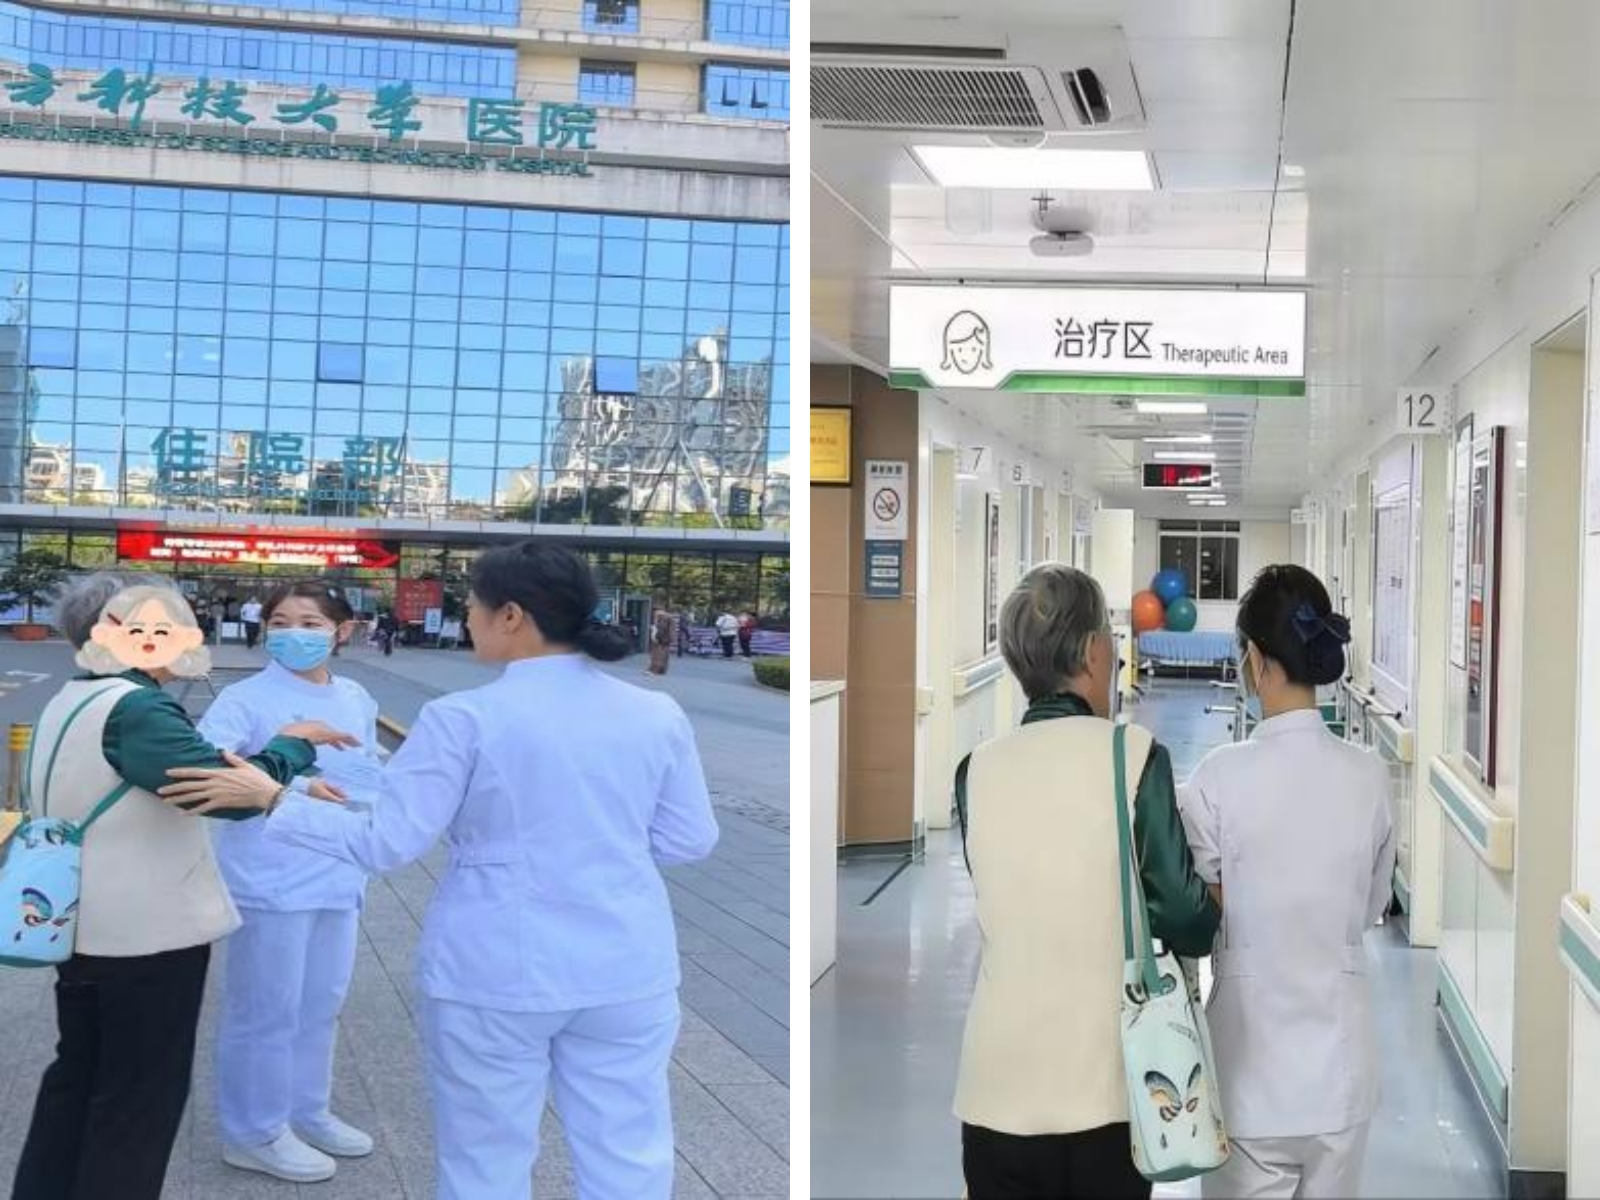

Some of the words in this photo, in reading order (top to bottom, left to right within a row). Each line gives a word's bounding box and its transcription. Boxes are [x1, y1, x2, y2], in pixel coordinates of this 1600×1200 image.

[1054, 317, 1154, 359] 治疗区
[1161, 342, 1249, 368] Therapeutic
[1254, 346, 1288, 365] Area
[1404, 394, 1436, 427] 12
[151, 427, 402, 485] 住院部
[969, 446, 985, 474] 7
